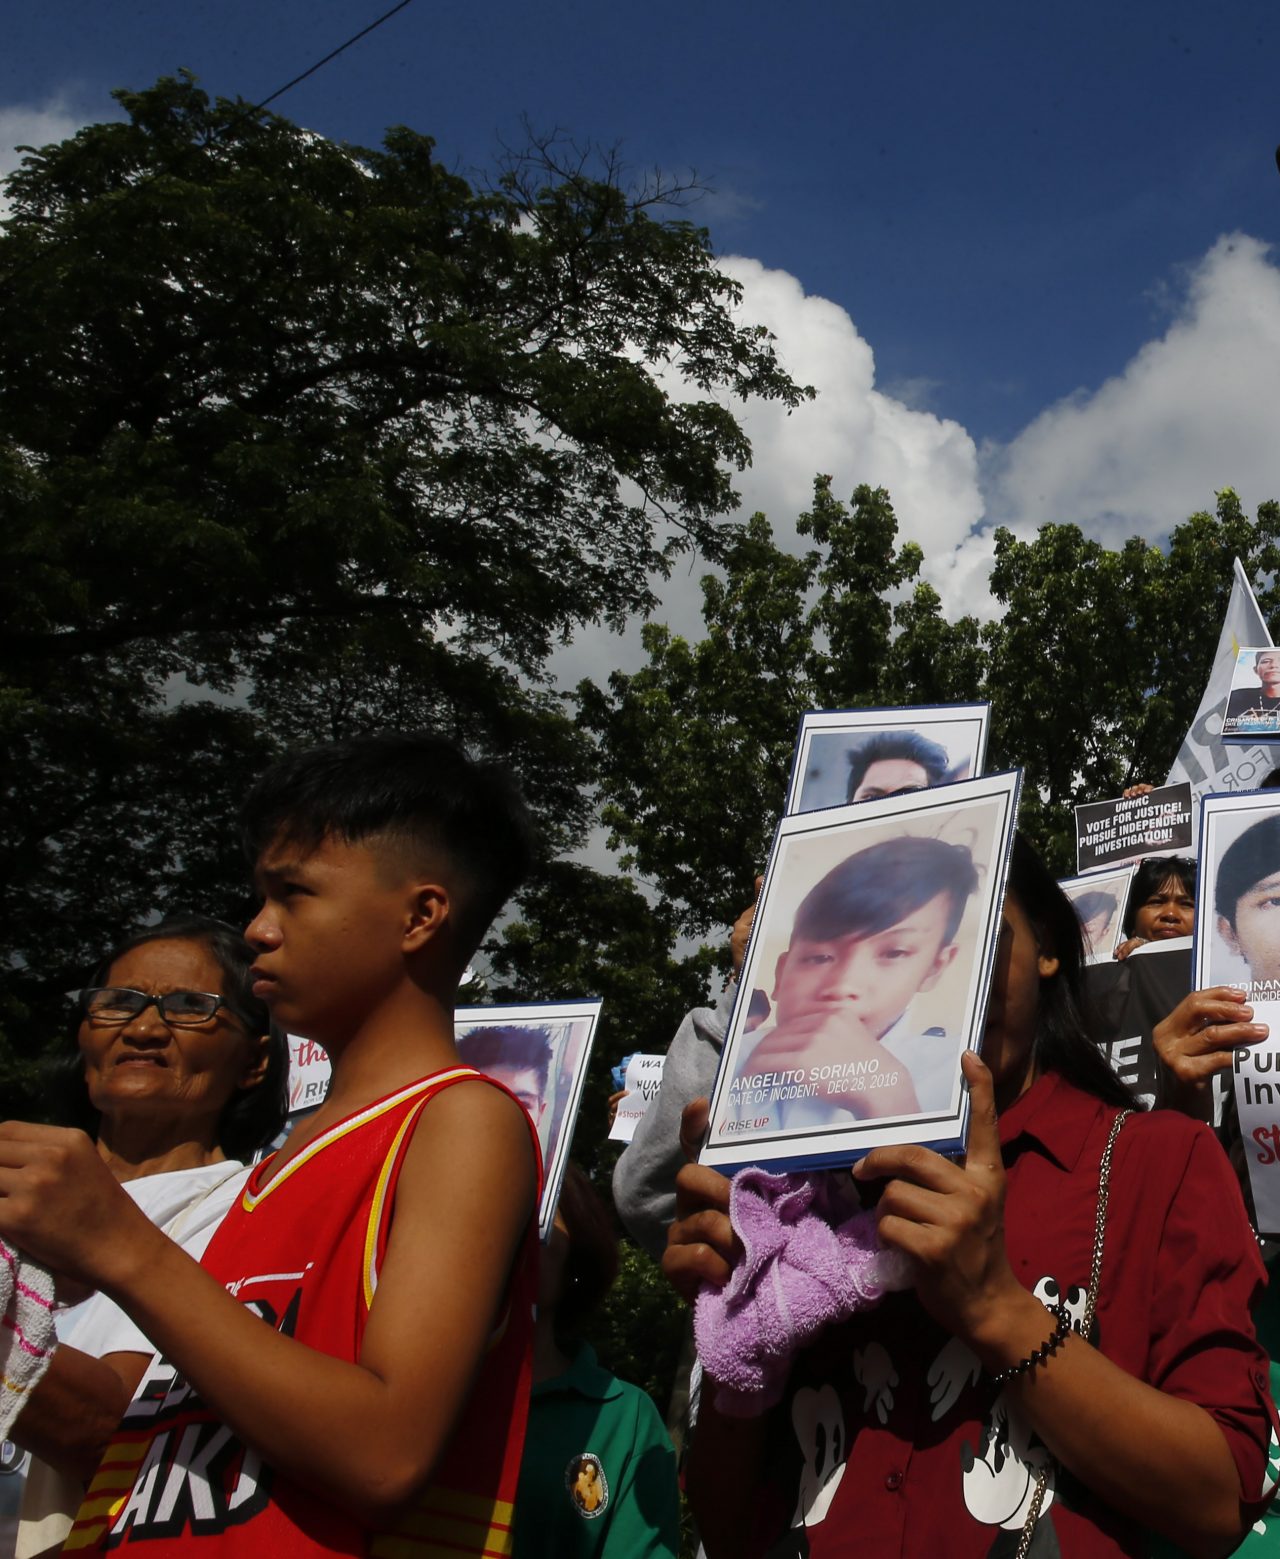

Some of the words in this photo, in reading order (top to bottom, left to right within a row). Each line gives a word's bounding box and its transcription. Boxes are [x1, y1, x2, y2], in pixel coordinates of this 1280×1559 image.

[1080, 828, 1116, 848] PURSUE
[1120, 812, 1191, 836] INDEPENDENT
[1086, 818, 1111, 834] VOTE
[1113, 812, 1132, 826] FOR
[1134, 802, 1182, 820] JUSTICE!
[1095, 828, 1173, 856] INVESTIGATION!
[727, 1092, 752, 1107] DATE
[755, 1089, 769, 1104] OF
[770, 1083, 820, 1101] INCIDENT:
[827, 1079, 849, 1095] DEC
[850, 1076, 867, 1091] 28,
[870, 1071, 898, 1089] 2016
[730, 1069, 805, 1091] ANGELITO
[809, 1058, 879, 1081] SORIANO
[727, 1119, 752, 1131] RISE
[753, 1117, 770, 1128] UP
